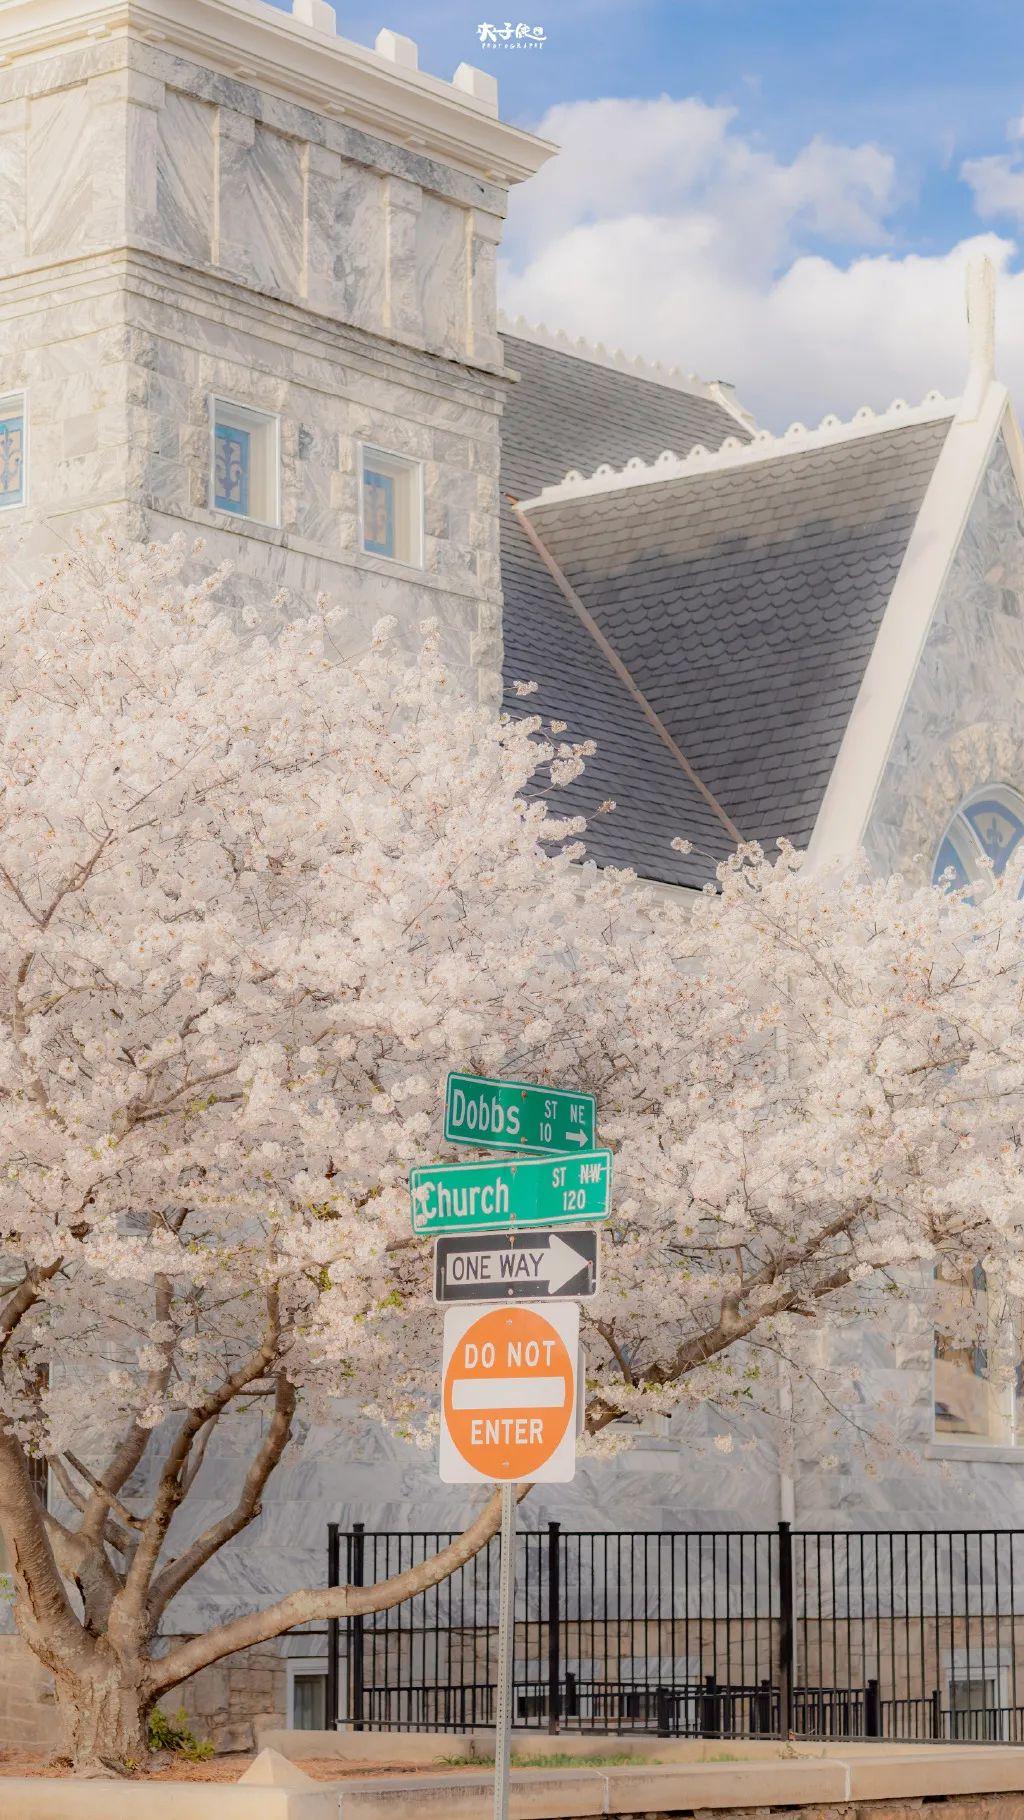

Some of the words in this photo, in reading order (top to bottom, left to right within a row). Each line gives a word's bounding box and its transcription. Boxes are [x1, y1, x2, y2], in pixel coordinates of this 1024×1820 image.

[452, 1089, 520, 1135] Dobbs
[544, 1100, 558, 1119] ST
[570, 1104, 585, 1124] NE
[539, 1122, 552, 1142] 10
[422, 1177, 509, 1219] Church
[552, 1167, 567, 1188] ST
[580, 1163, 601, 1184] NW
[563, 1189, 586, 1211] 120
[452, 1255, 491, 1280] ONE
[499, 1252, 544, 1278] WAY
[464, 1343, 495, 1369] DO
[507, 1340, 555, 1367] NOT
[470, 1418, 544, 1445] ENTER
